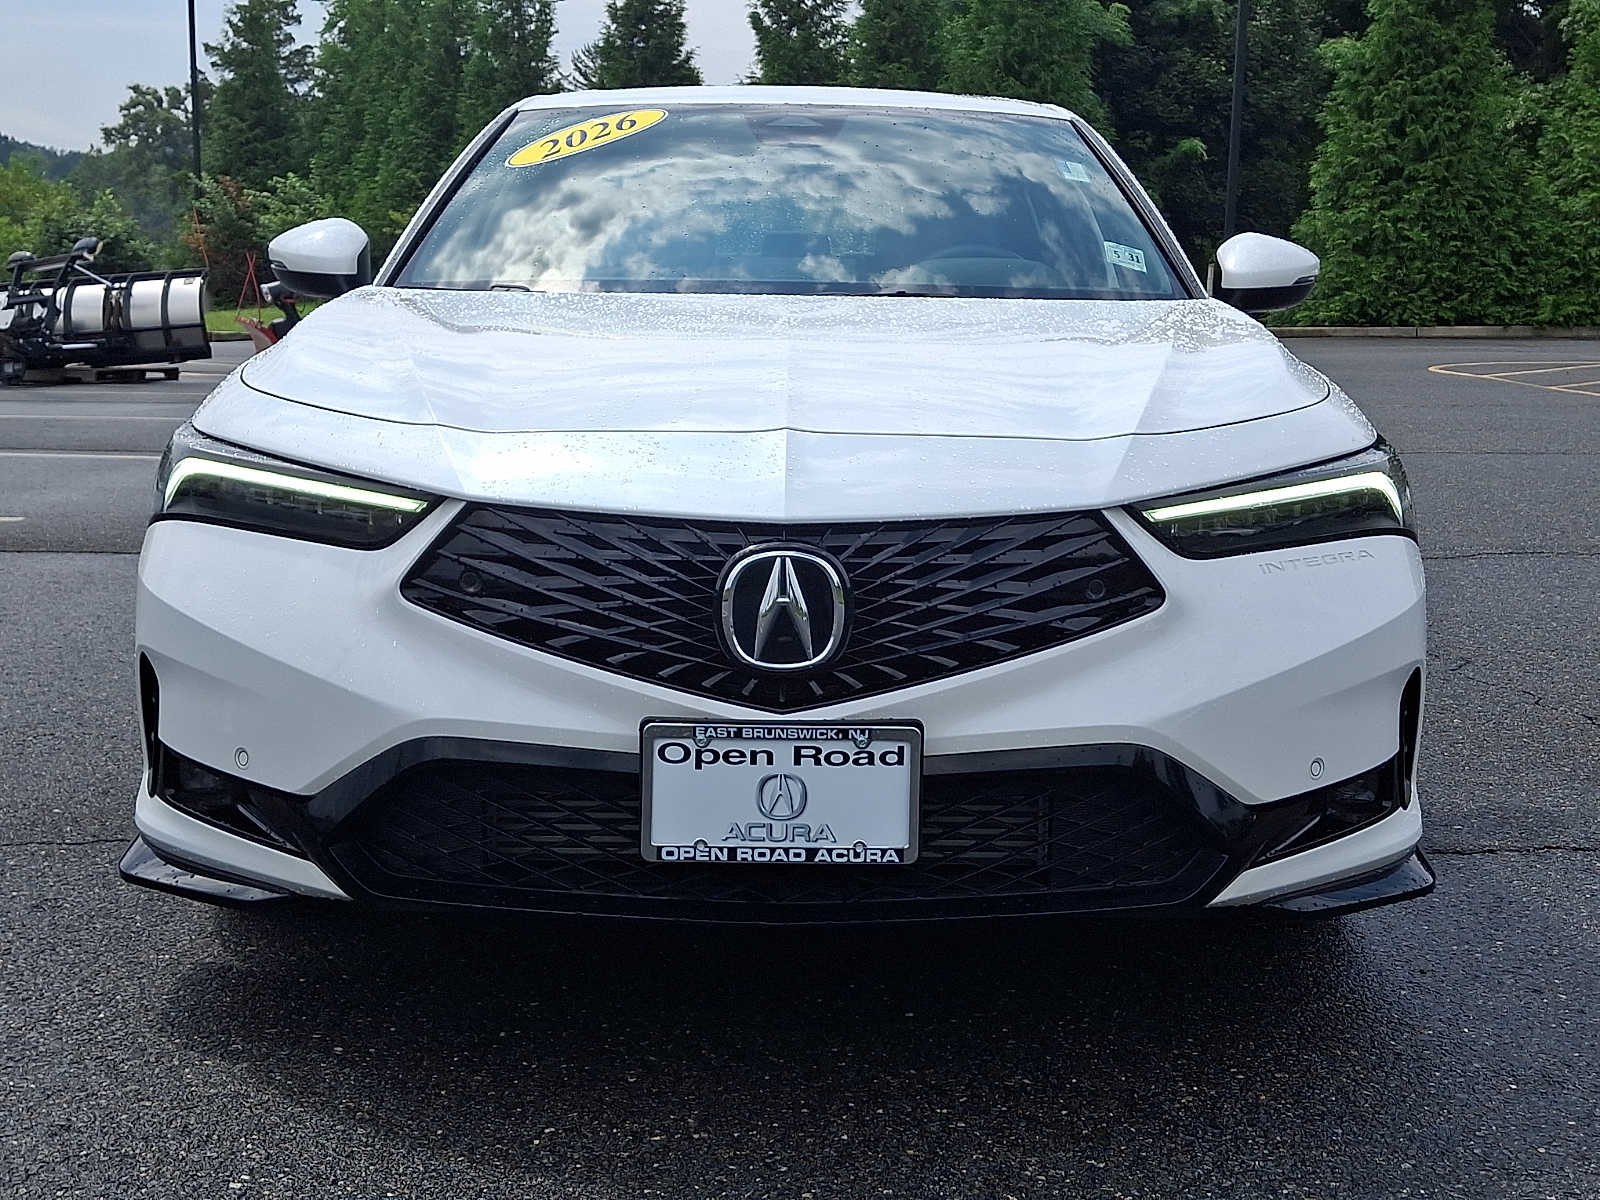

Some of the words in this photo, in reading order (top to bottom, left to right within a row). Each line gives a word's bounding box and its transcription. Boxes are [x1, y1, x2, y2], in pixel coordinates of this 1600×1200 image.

[540, 113, 637, 159] 2026
[1113, 250, 1121, 259] 5
[1258, 550, 1376, 574] INTEGRA
[695, 727, 737, 738] EAST
[848, 729, 869, 739] NJ
[657, 742, 774, 770] Open
[793, 745, 905, 766] Road
[721, 822, 837, 842] ACURA
[661, 847, 728, 861] OPEN
[737, 848, 806, 862] ROAD
[814, 848, 900, 863] ACURA
